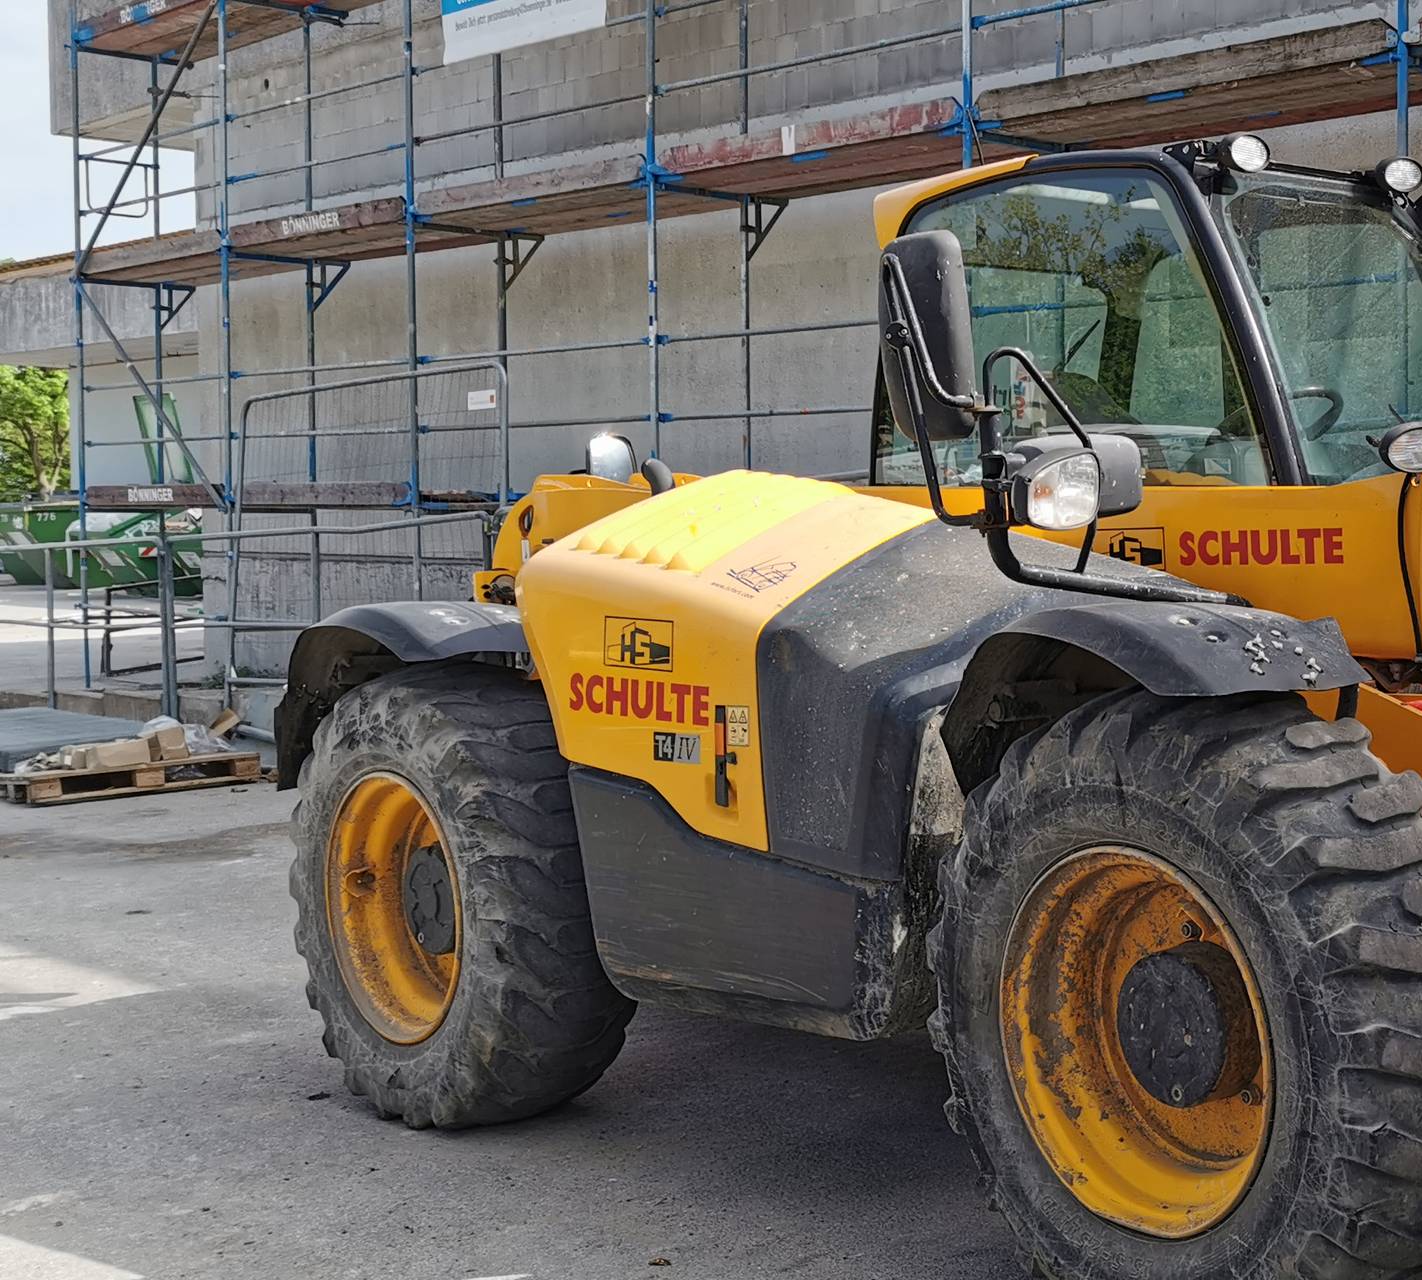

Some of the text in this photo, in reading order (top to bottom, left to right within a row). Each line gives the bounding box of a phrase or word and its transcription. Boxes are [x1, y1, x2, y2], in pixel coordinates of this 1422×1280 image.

[281, 211, 340, 235] BÖNNINGER
[1179, 528, 1345, 566] SCHULTE
[569, 672, 710, 726] SCHULTE
[655, 735, 698, 760] T4 IV
